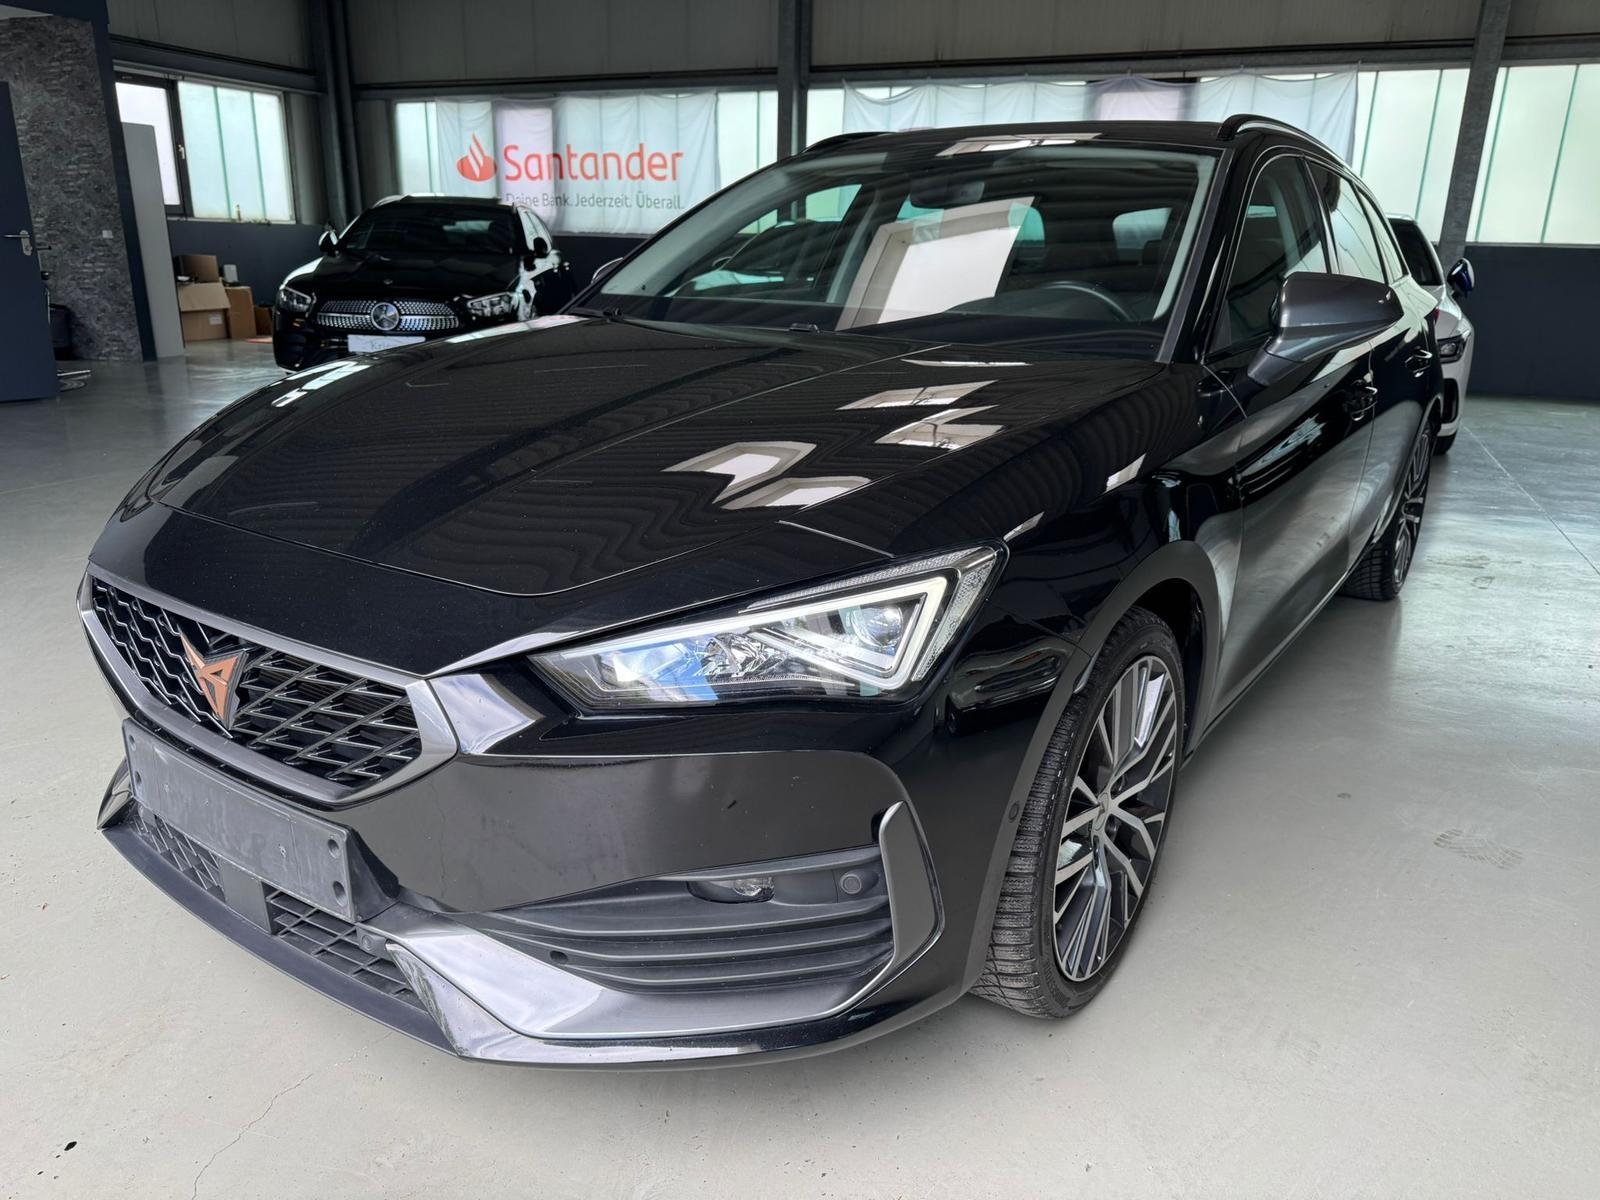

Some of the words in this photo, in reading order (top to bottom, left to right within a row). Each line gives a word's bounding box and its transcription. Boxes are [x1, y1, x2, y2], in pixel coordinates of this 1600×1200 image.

[503, 143, 684, 183] Santander
[542, 193, 573, 207] Bank.
[575, 193, 632, 208] Jederzeit.
[636, 191, 685, 210] Überall.
